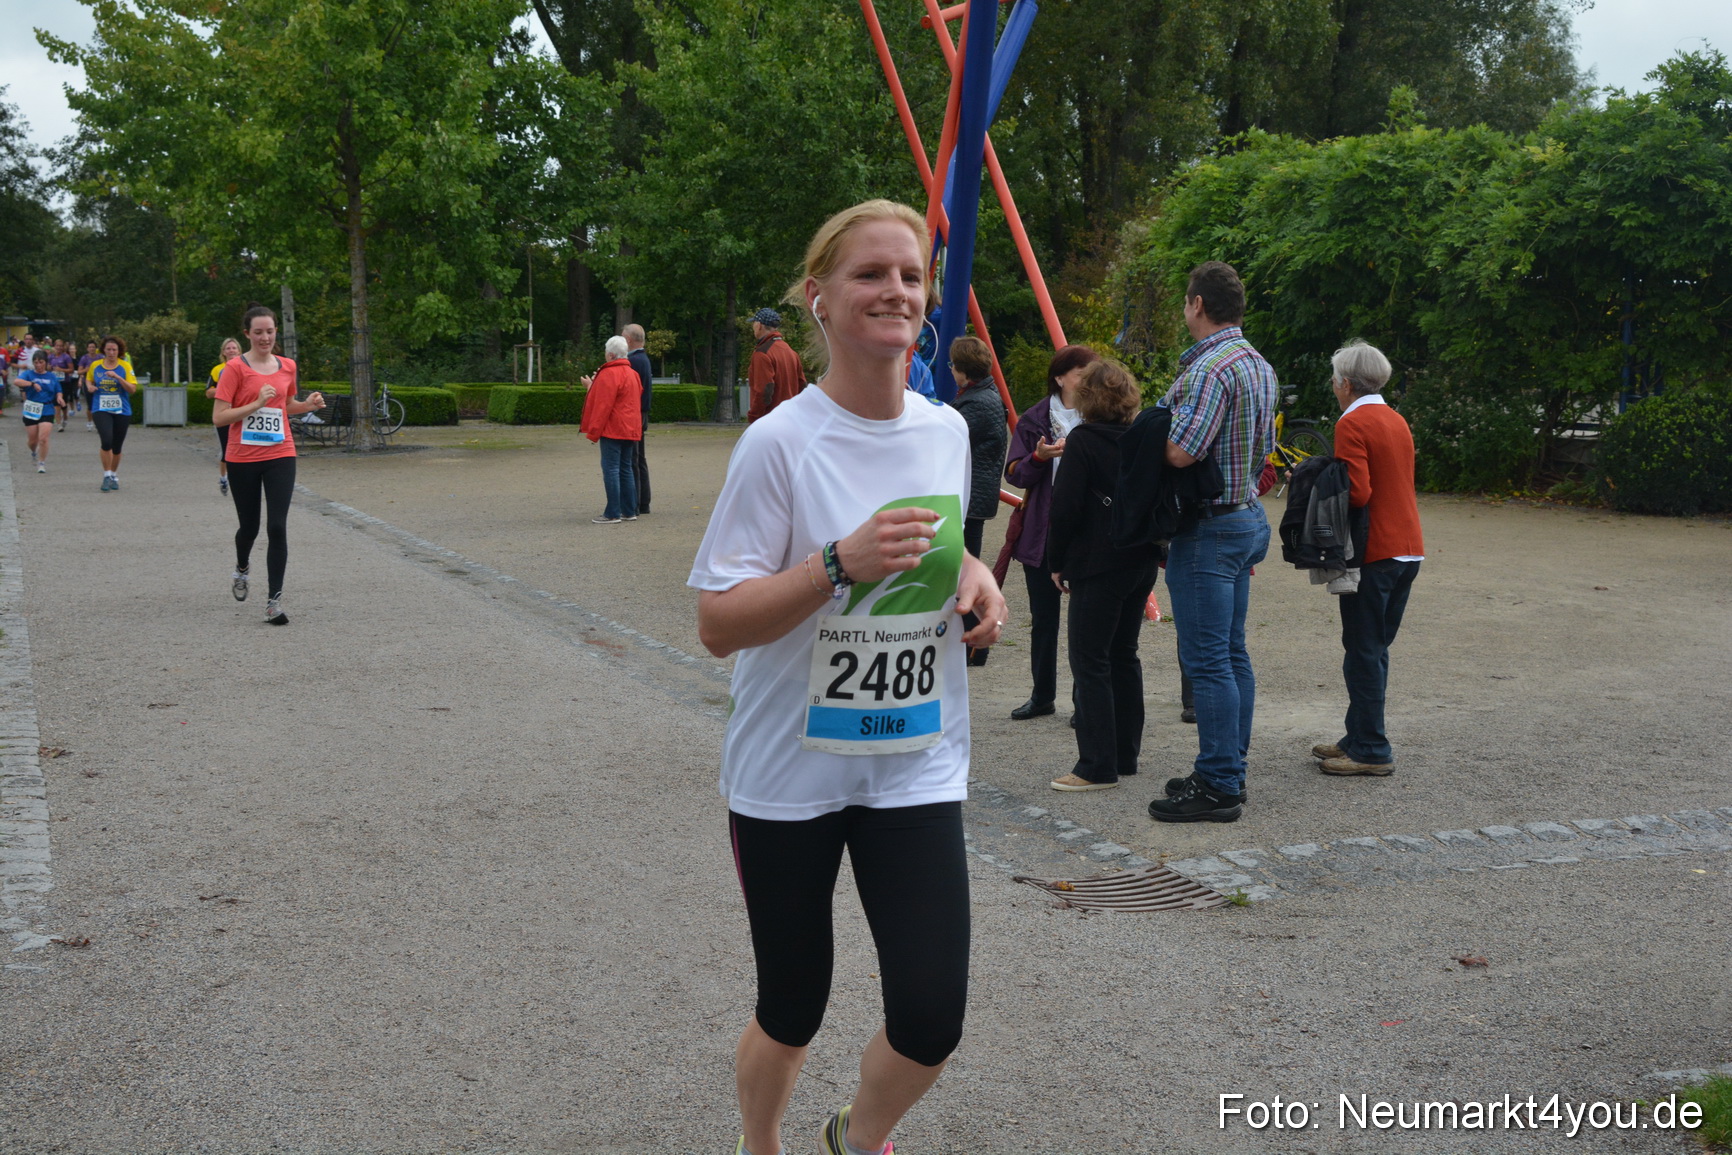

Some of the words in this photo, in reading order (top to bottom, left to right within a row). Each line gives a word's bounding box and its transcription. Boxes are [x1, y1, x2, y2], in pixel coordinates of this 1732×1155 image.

[102, 399, 120, 408] 2629
[247, 415, 280, 432] 2359
[819, 629, 871, 643] PARTL
[874, 626, 932, 643] Neumarkt
[825, 645, 936, 701] 2488
[860, 715, 906, 735] Silke
